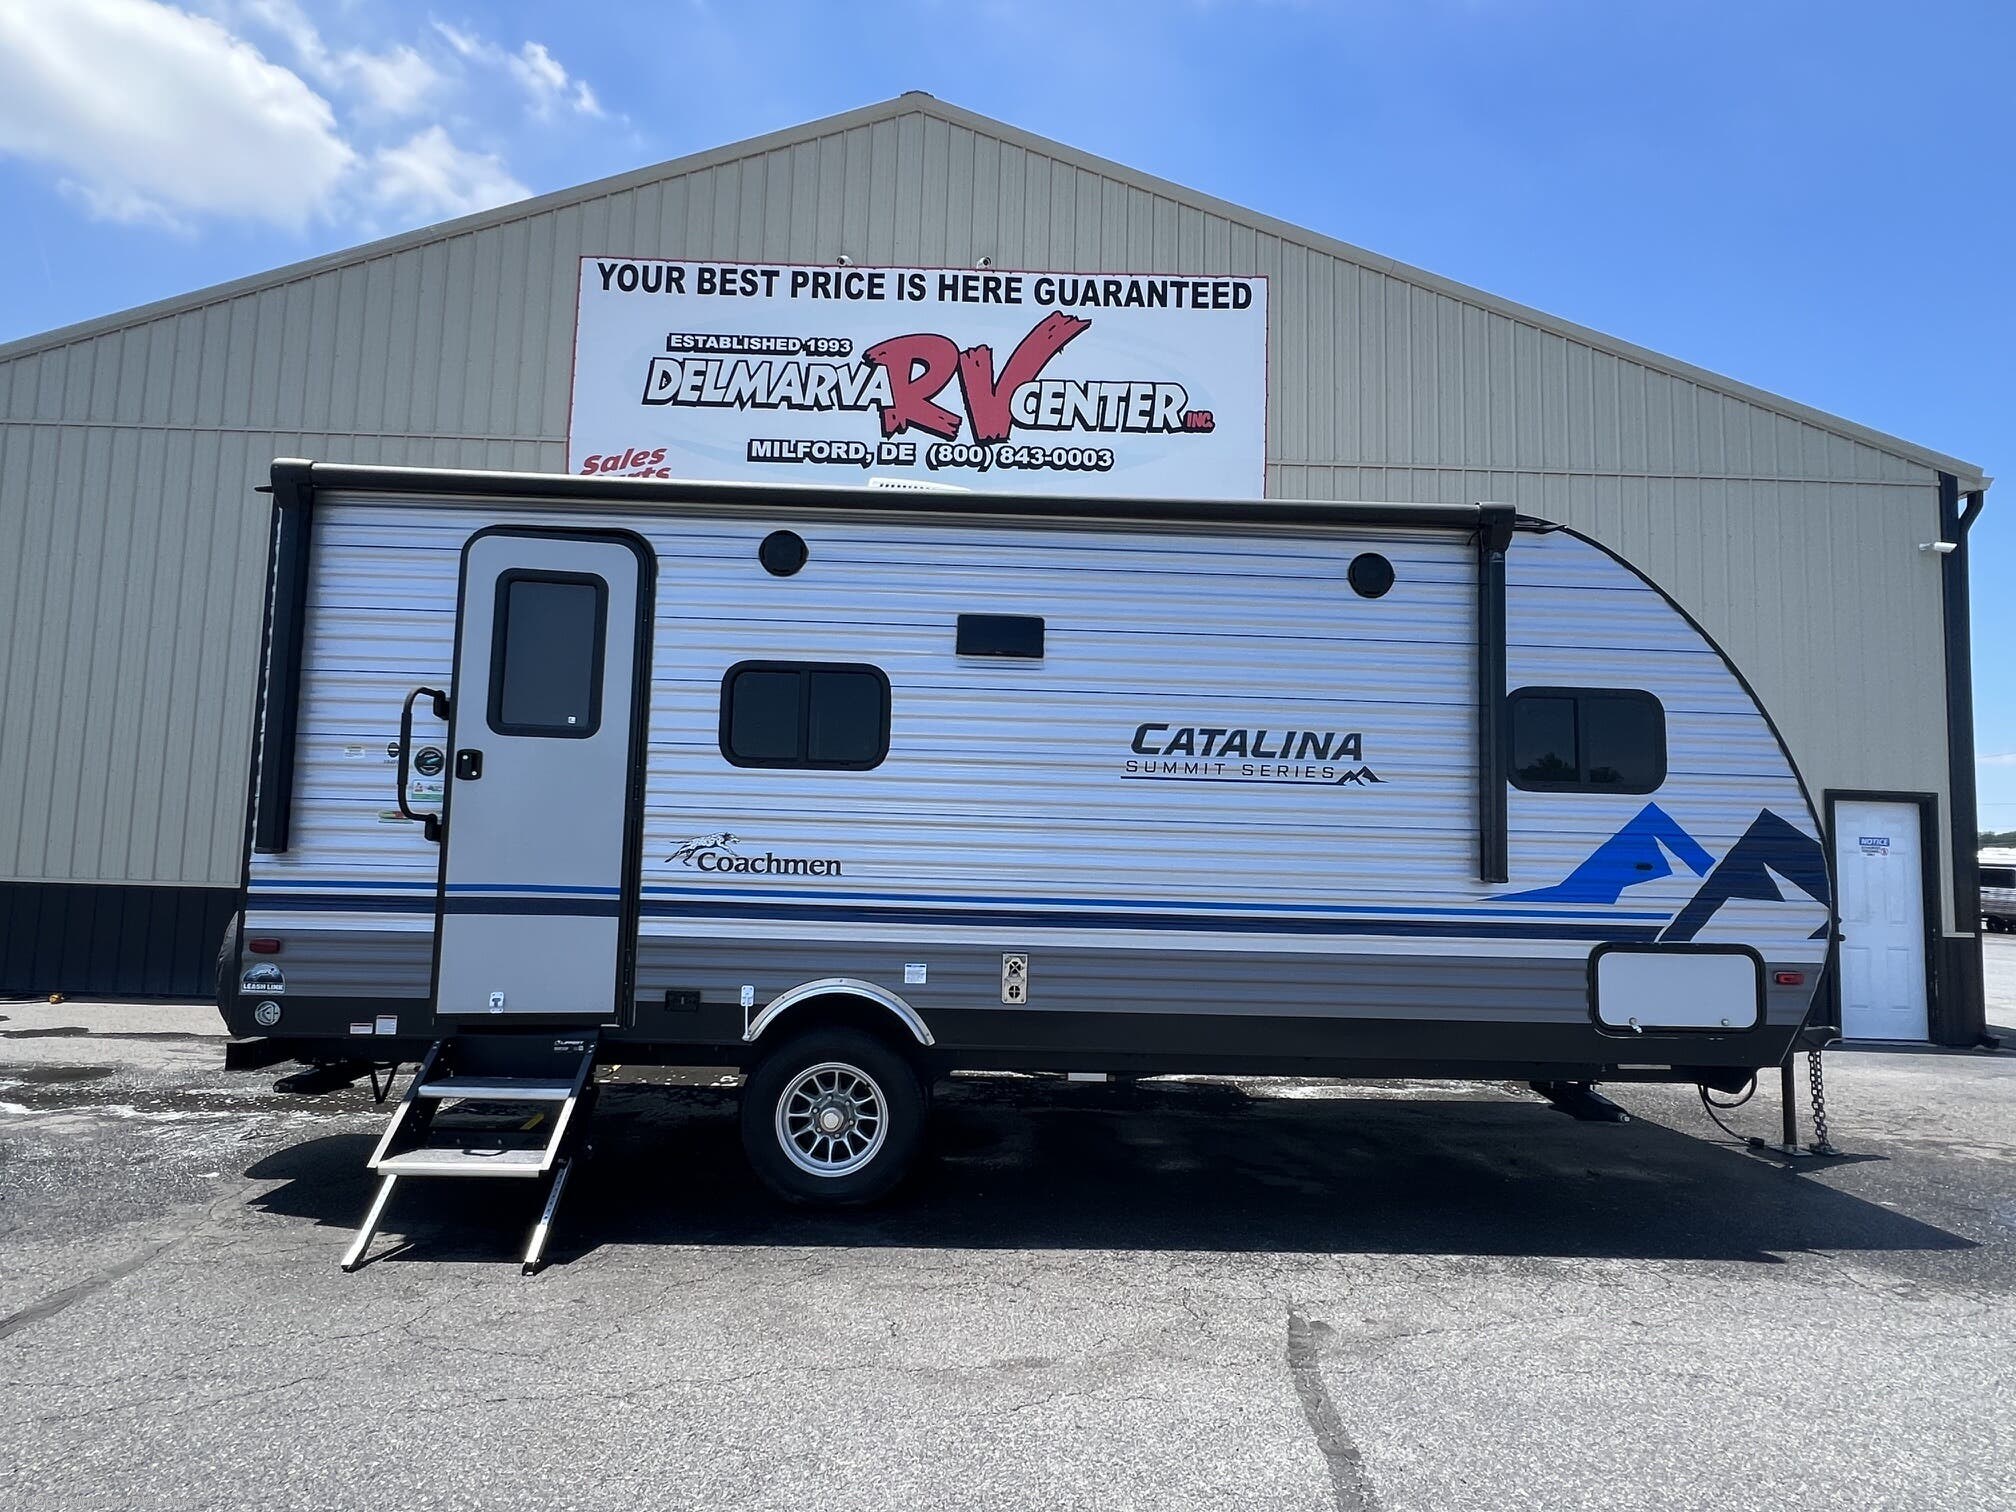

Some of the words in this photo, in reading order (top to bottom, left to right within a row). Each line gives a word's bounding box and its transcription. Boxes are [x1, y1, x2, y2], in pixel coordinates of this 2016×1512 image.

[598, 263, 686, 294] YOUR
[697, 267, 779, 297] BEST
[790, 271, 886, 300] PRICE
[897, 273, 926, 301] IS
[938, 274, 1022, 304] HERE
[1033, 278, 1252, 309] GUARANTEED
[668, 334, 801, 354] ESTABLISHED
[805, 337, 852, 355] 1993
[643, 357, 895, 410] DELMARVA
[863, 310, 1092, 445] RV
[1009, 379, 1189, 432] CENTER
[580, 448, 667, 475] Sales
[750, 440, 873, 466] MILFORD,
[879, 442, 916, 463] DE
[928, 444, 993, 470] (800)
[998, 446, 1114, 469] 843-0003
[1130, 722, 1362, 761] CATALINA
[1125, 760, 1226, 776] SUMMIT
[1241, 764, 1335, 779] SERIES
[1861, 838, 1888, 846] NOTICE
[697, 851, 842, 876] Coachmen
